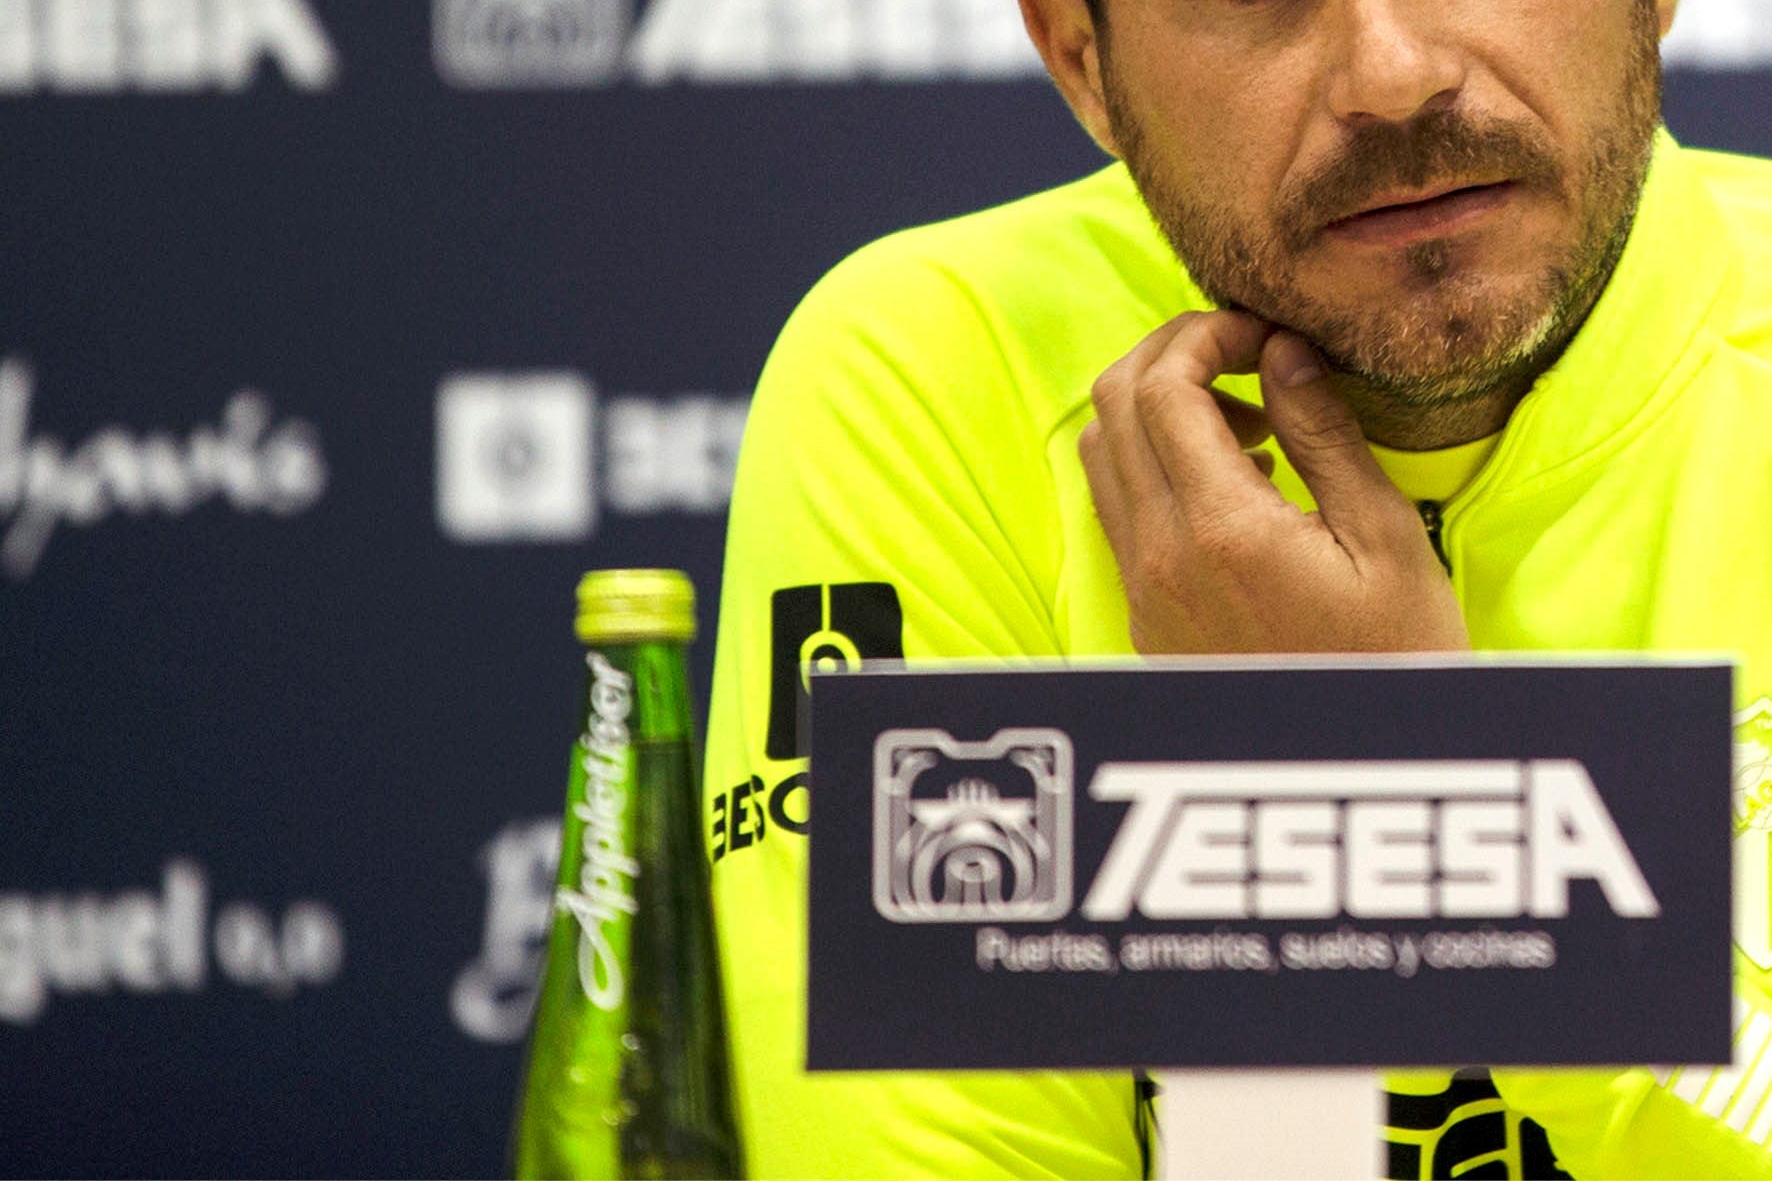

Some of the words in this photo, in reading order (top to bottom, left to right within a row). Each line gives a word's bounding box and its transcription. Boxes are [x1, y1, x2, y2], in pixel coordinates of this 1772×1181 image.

[556, 649, 640, 1011] Appletiser
[1081, 758, 1661, 922] TESESA
[975, 926, 1118, 975] Puertas,
[1119, 925, 1278, 975] armarios,
[1279, 924, 1396, 970] suelos
[1393, 931, 1419, 978] y
[1420, 923, 1556, 969] cocinas
